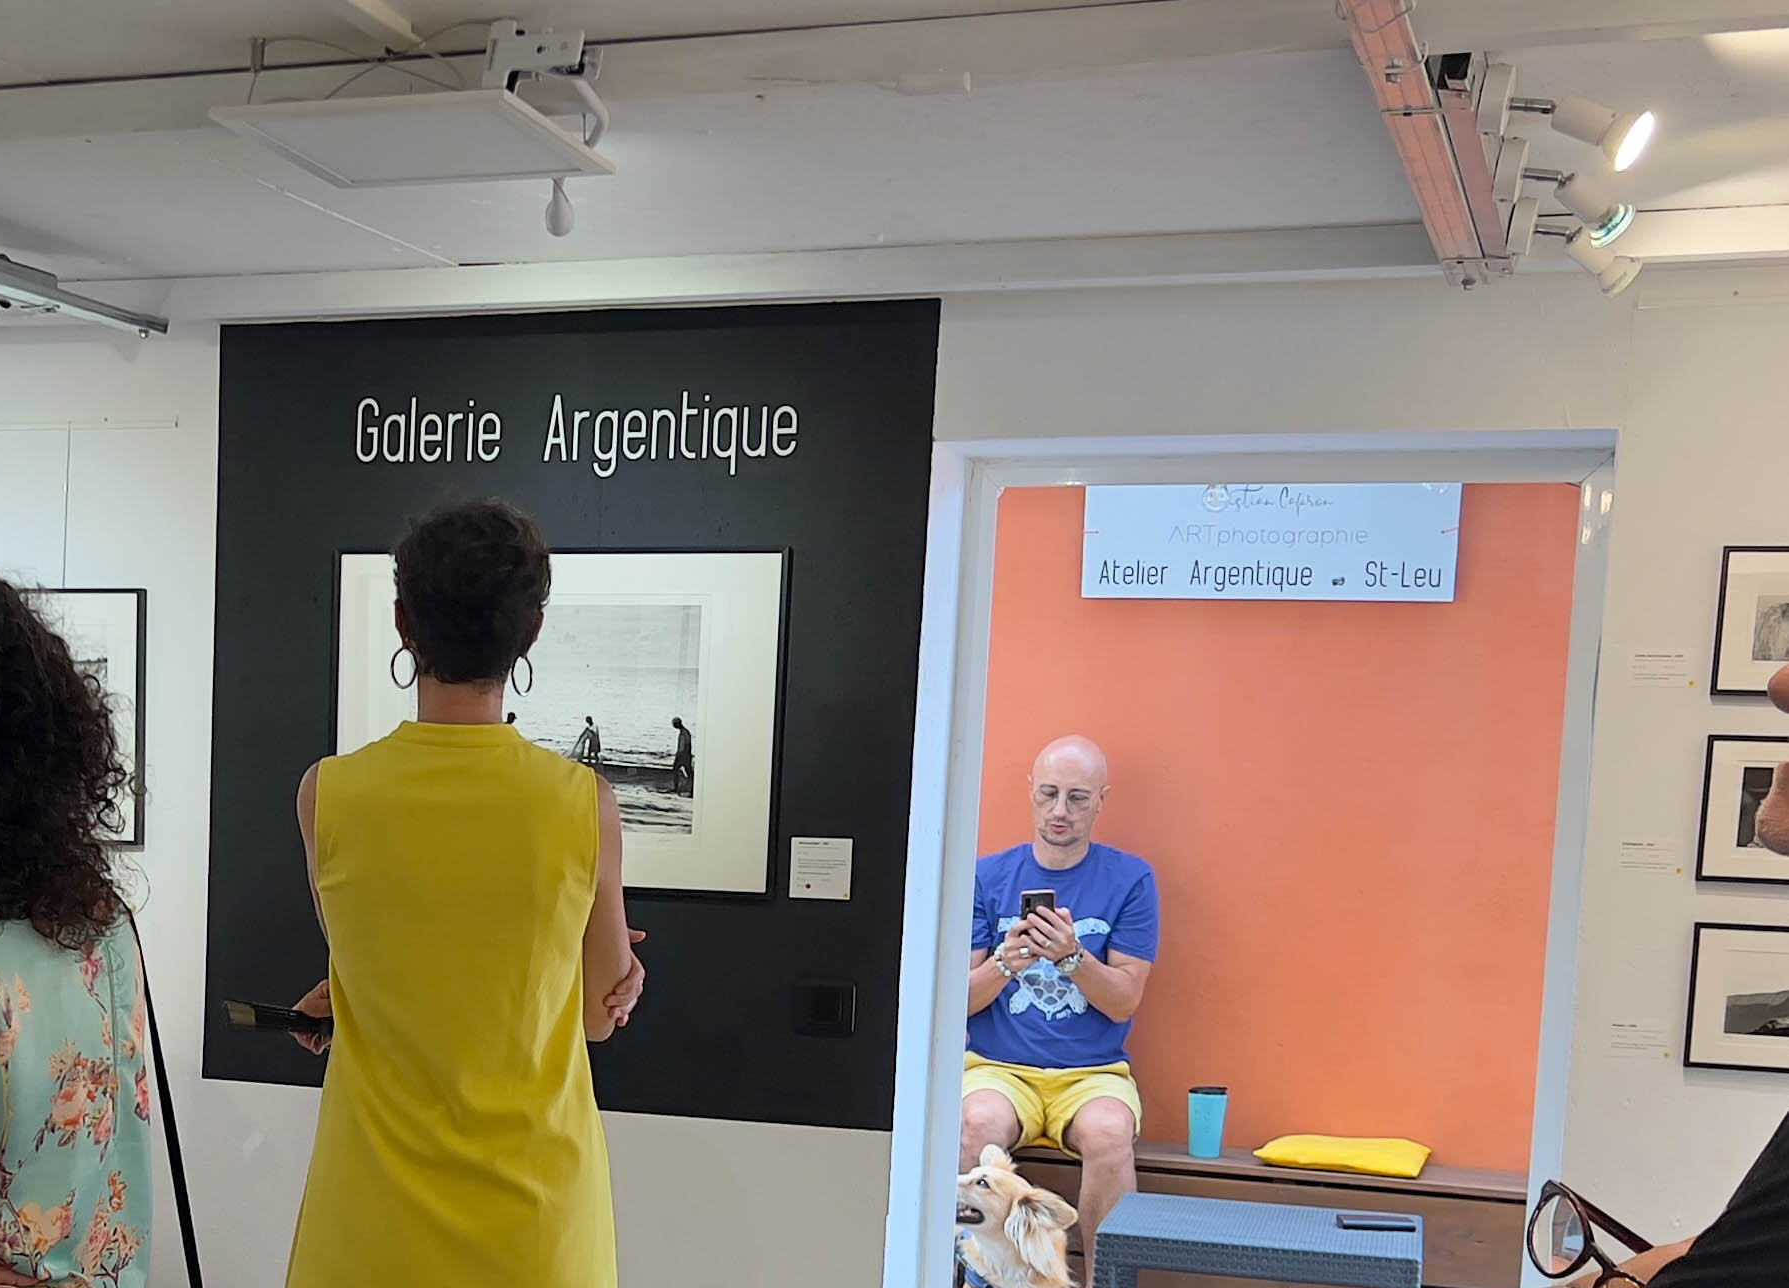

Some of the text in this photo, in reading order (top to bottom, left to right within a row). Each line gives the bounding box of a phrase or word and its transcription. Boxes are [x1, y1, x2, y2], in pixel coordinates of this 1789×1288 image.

[356, 391, 798, 478] Galerie Argentique
[1098, 559, 1169, 586] Atelier
[1189, 559, 1313, 592] Argentique
[1364, 560, 1442, 588] St-Leu
